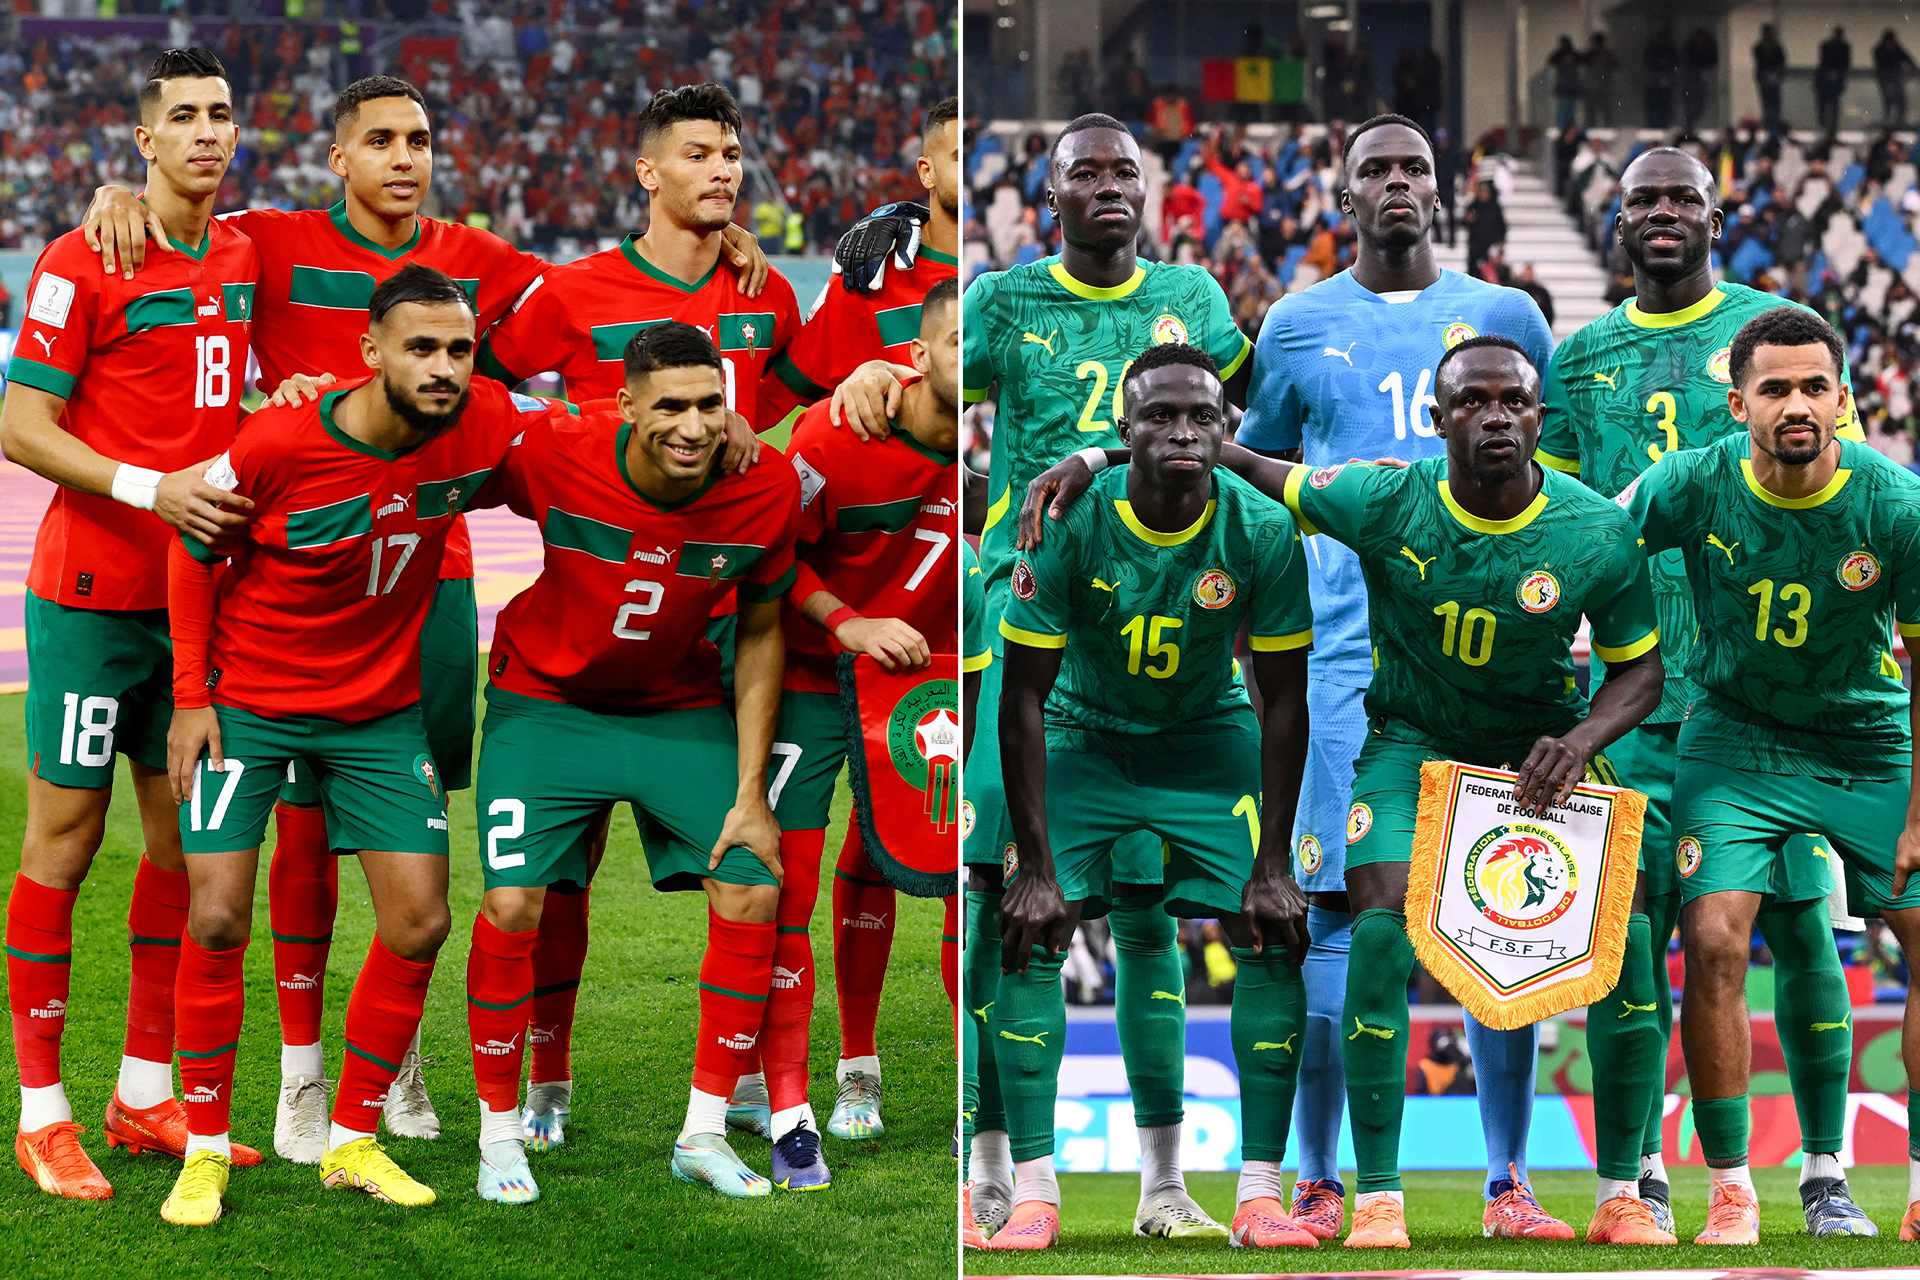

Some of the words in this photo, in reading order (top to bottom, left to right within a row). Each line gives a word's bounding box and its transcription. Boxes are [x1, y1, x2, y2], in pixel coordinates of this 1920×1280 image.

[198, 305, 218, 316] PUMA
[195, 335, 231, 409] 18
[1378, 368, 1440, 440] 16
[1646, 391, 1679, 463] 3
[377, 502, 404, 519] PUMA
[920, 504, 951, 516] PUMA
[365, 532, 422, 597] 17
[633, 550, 666, 565] PUMA
[903, 528, 952, 592] 7
[612, 579, 665, 641] 2
[1748, 578, 1812, 648] 13
[1434, 600, 1497, 666] 10
[1120, 615, 1183, 679] 15
[909, 703, 931, 725] ROYALE
[59, 692, 119, 767] 18
[768, 742, 803, 812] 7
[190, 758, 246, 832] 17
[1465, 783, 1521, 802] FEDERATI
[1497, 803, 1512, 814] DE
[427, 817, 447, 830] PUM
[487, 798, 525, 870] 2
[1515, 824, 1576, 878] SÉNÉGALAISE
[1464, 832, 1497, 901] FÉDÉRATION
[1557, 896, 1571, 911] DE
[843, 917, 881, 930] PUMA
[1496, 910, 1558, 927] FOOTBALL
[280, 981, 313, 990] PUMA
[30, 1008, 65, 1018] PUMA
[475, 1043, 510, 1055] PUMA
[717, 1036, 753, 1050] PUMA
[184, 1093, 213, 1103] PUMA
[121, 1114, 158, 1140] ULTRA
